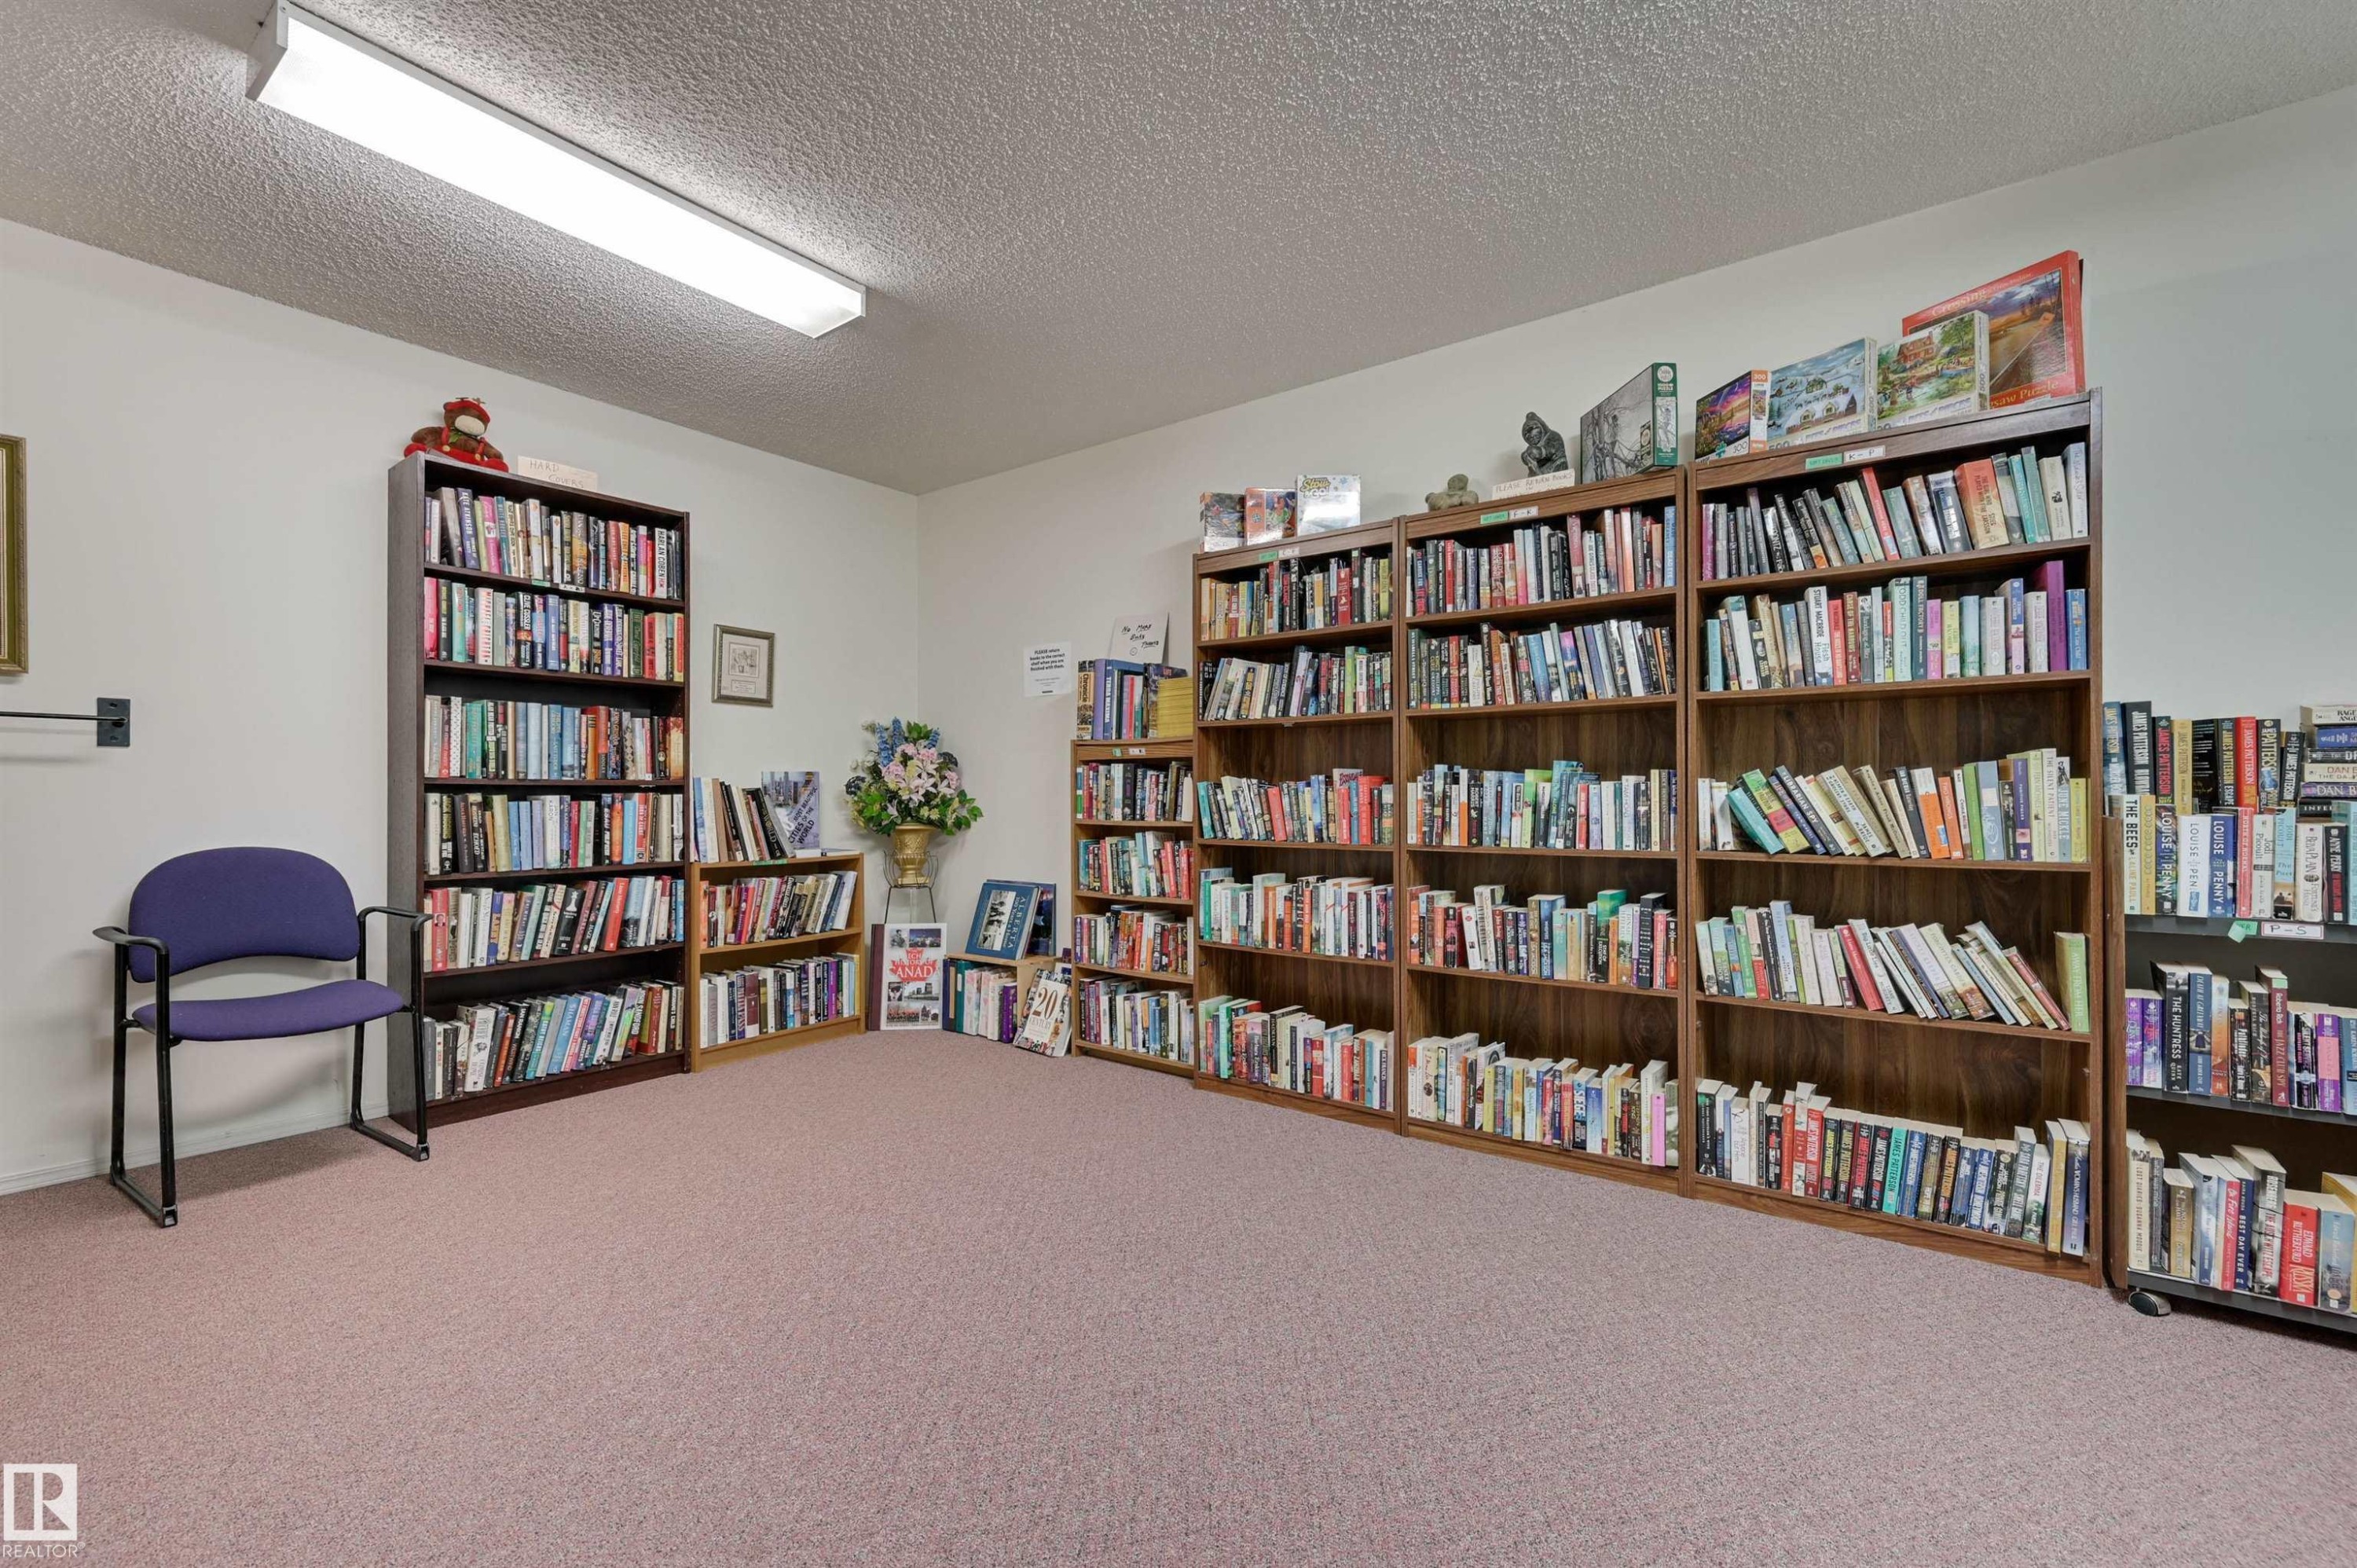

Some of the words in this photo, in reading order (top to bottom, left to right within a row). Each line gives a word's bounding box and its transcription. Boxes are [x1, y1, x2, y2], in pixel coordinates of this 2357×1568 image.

[2019, 380, 2058, 400] Puzzle
[1732, 441, 1748, 452] 300
[530, 460, 559, 472] HARD
[1302, 478, 1330, 490] Stow
[1496, 482, 1521, 493] PLEASE
[461, 492, 471, 506] KATE
[464, 508, 473, 534] ATKINSON
[1813, 589, 1823, 609] STUART
[1898, 588, 1907, 605] ODD
[1816, 610, 1824, 637] MACBRIDE
[1898, 607, 1907, 632] CHILD
[1848, 628, 1857, 653] NARROWS
[1820, 643, 1830, 661] Flesh
[2132, 712, 2147, 731] JAMES
[2133, 732, 2150, 764] PATTERSON
[2158, 728, 2169, 751] JAMES
[2223, 731, 2233, 749] JAMES
[2243, 728, 2252, 746] JAMES
[2224, 750, 2234, 783] PATTERSON
[2287, 753, 2297, 770] JAMES
[2047, 770, 2055, 790] SILENT
[2159, 753, 2170, 794] PATTERSON
[2224, 786, 2234, 805] ESCAPE
[2283, 771, 2296, 800] PATTERSON
[2319, 786, 2344, 795] DAN
[1783, 775, 1808, 809] LIBRARIAN
[1806, 811, 1817, 823] SPY
[2047, 793, 2057, 818] PATIENT
[2058, 788, 2069, 808] JUNE
[794, 809, 804, 822] MOST
[2125, 800, 2138, 820] THE
[443, 814, 452, 839] HIGGINS
[788, 821, 804, 843] CITIES
[797, 819, 815, 844] WORLD
[2058, 811, 2070, 840] MICKLE
[2126, 823, 2140, 848] BEES
[2161, 812, 2173, 849] LOUISE
[2189, 823, 2199, 857] LOUISE
[2213, 821, 2225, 855] LOUISE
[2255, 833, 2265, 859] Picoult
[2264, 838, 2275, 855] Jodi
[2330, 837, 2342, 852] ANNE
[2330, 854, 2343, 871] PERRY
[2161, 863, 2173, 898] PENNY
[2214, 871, 2227, 903] PENNY
[1007, 896, 1026, 949] ALBERTA
[1866, 942, 1875, 957] Little
[2072, 953, 2080, 974] AWAY
[1032, 986, 1058, 1019] 20
[2074, 1001, 2083, 1017] HER
[2172, 996, 2182, 1012] THE
[562, 1004, 576, 1036] SHAMAN
[631, 1004, 643, 1034] SANDFORD
[2172, 1014, 2183, 1059] HUNTRESS
[2275, 1039, 2285, 1055] JAZZ
[2275, 1075, 2286, 1087] SPY
[1574, 1090, 1585, 1116] SIEGE
[1807, 1118, 1816, 1135] JAMES
[1807, 1135, 1817, 1160] PATTERSON
[1826, 1129, 1835, 1148] JAMES
[1842, 1131, 1852, 1147] JAMES
[1859, 1137, 1869, 1155] JAMES
[1877, 1138, 1887, 1155] JAMES
[1893, 1138, 1901, 1156] JAMES
[1824, 1148, 1834, 1177] PATTERSON
[1839, 1151, 1851, 1181] PATTERSON
[1872, 1155, 1886, 1181] PATTERSON
[1948, 1149, 1958, 1166] JAMES
[1856, 1156, 1868, 1186] PATTERSON
[1889, 1159, 1901, 1192] PATTERSON
[1941, 1167, 1956, 1197] PATTERSON
[2033, 1172, 2044, 1196] DILEMMA
[2303, 1230, 2312, 1257] EDWARD
